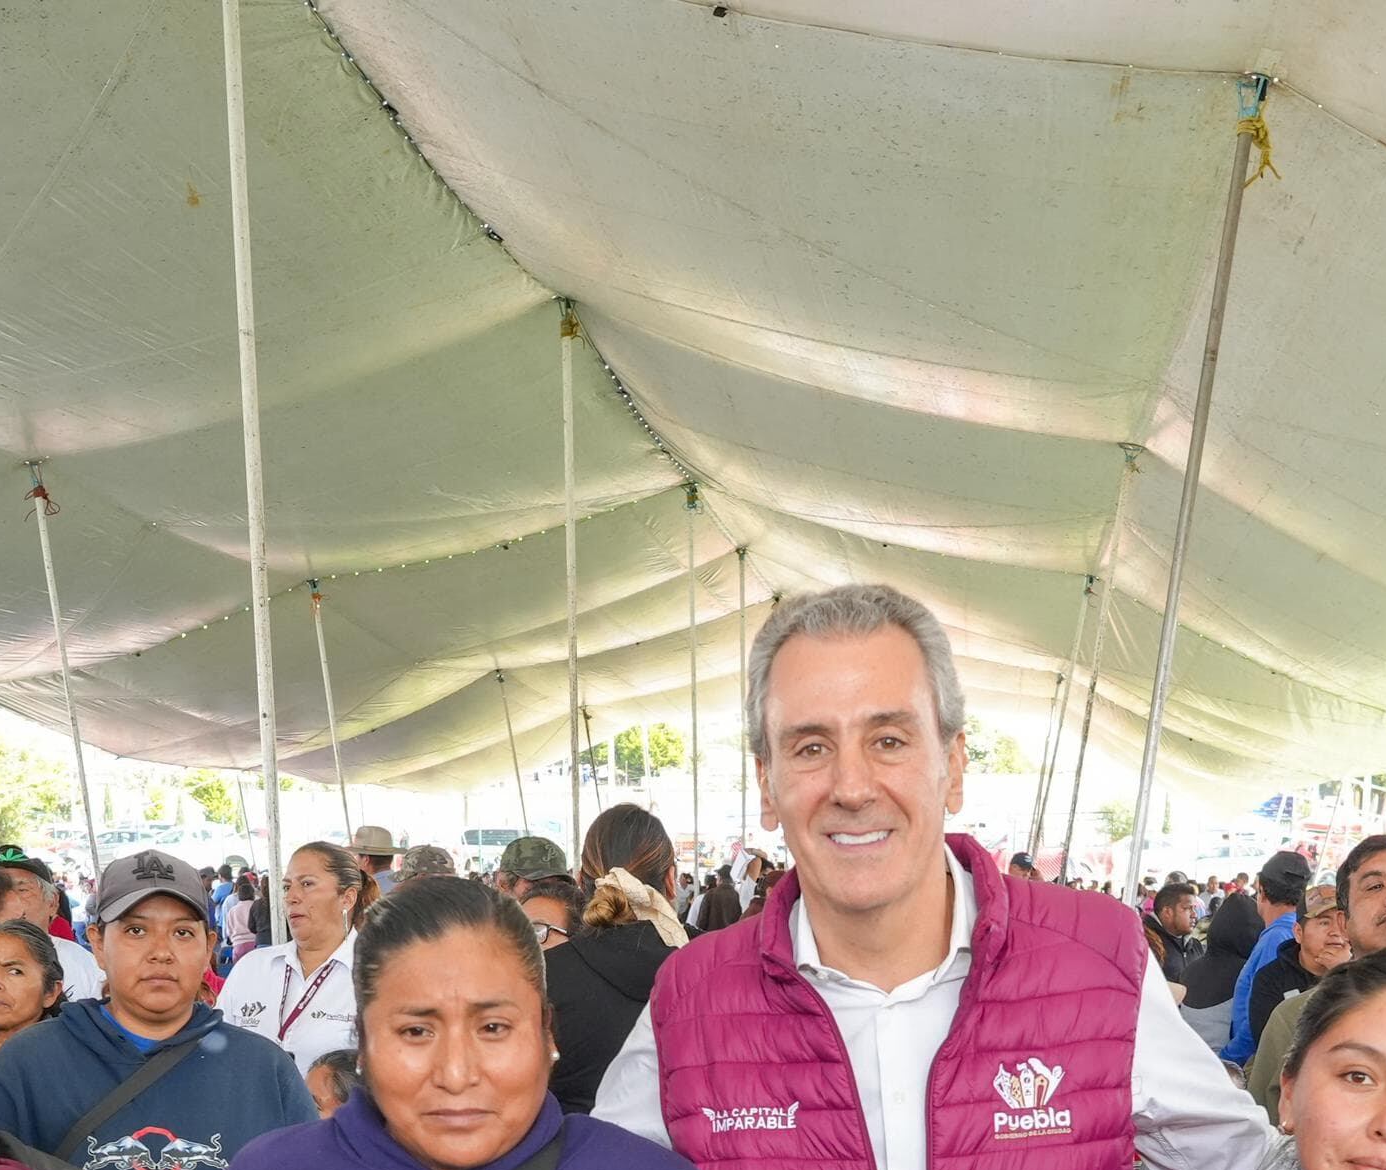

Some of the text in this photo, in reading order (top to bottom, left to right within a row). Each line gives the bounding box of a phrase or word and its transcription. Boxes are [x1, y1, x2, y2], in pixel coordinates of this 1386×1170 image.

[715, 1107, 788, 1119] LA CAPITAL
[993, 1106, 1071, 1133] Puebla
[712, 1116, 797, 1133] IMPARABLE
